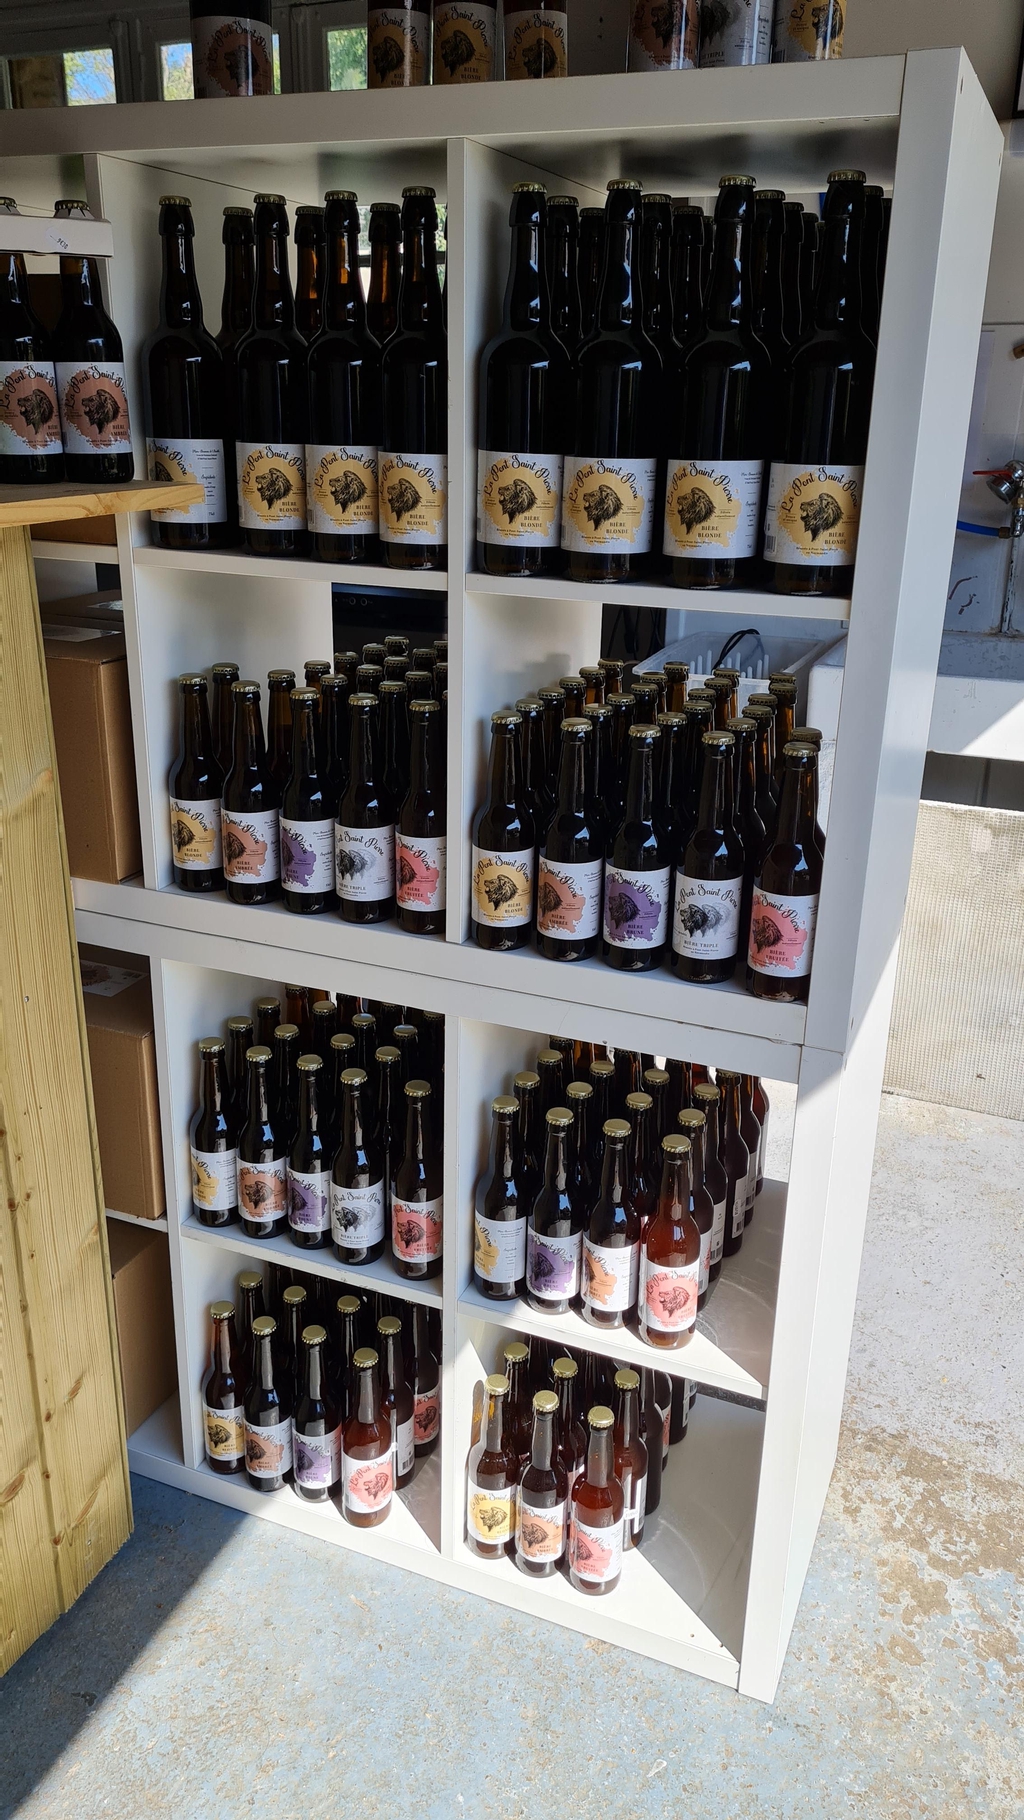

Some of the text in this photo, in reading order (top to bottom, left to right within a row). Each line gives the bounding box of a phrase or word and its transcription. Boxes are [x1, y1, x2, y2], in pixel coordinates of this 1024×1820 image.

[381, 13, 403, 28] Saint
[451, 6, 474, 24] Saint
[472, 19, 488, 47] Pierre
[514, 22, 532, 43] Pont
[534, 14, 555, 29] Saint
[5, 374, 26, 392] Pont
[26, 364, 48, 379] Saint
[70, 375, 90, 392] Pont
[91, 364, 115, 380] Saint
[168, 451, 188, 476] Pierre
[242, 445, 306, 486] La Pont Saint Pierre
[315, 447, 378, 488] La Pont Saint Pierr
[396, 455, 419, 470] Saint
[418, 468, 438, 494] Pierre
[484, 454, 552, 496] La Pont Saint Pierre
[568, 459, 638, 504] La Pont Saint Pierre
[672, 467, 688, 490] Pont
[690, 462, 714, 478] Saint
[713, 474, 733, 504] Pierre
[781, 466, 858, 512] La Pont Saint Pierre
[174, 802, 208, 832] Saint Pierre
[242, 823, 260, 845] Pierre
[344, 831, 364, 844] Saint
[364, 838, 384, 856] Pierre
[414, 847, 430, 871] Pierre
[478, 860, 492, 874] Pont
[495, 855, 516, 866] Saint
[516, 862, 530, 882] Pierre
[541, 862, 577, 899] Saint Pierre
[616, 871, 654, 907] Saint Pierre
[680, 888, 696, 903] Pont
[698, 884, 720, 896] Saint
[720, 889, 738, 909] Pierre
[761, 893, 800, 933] Saint Pierre
[347, 1192, 366, 1200] Saint
[404, 1204, 423, 1214] Saint
